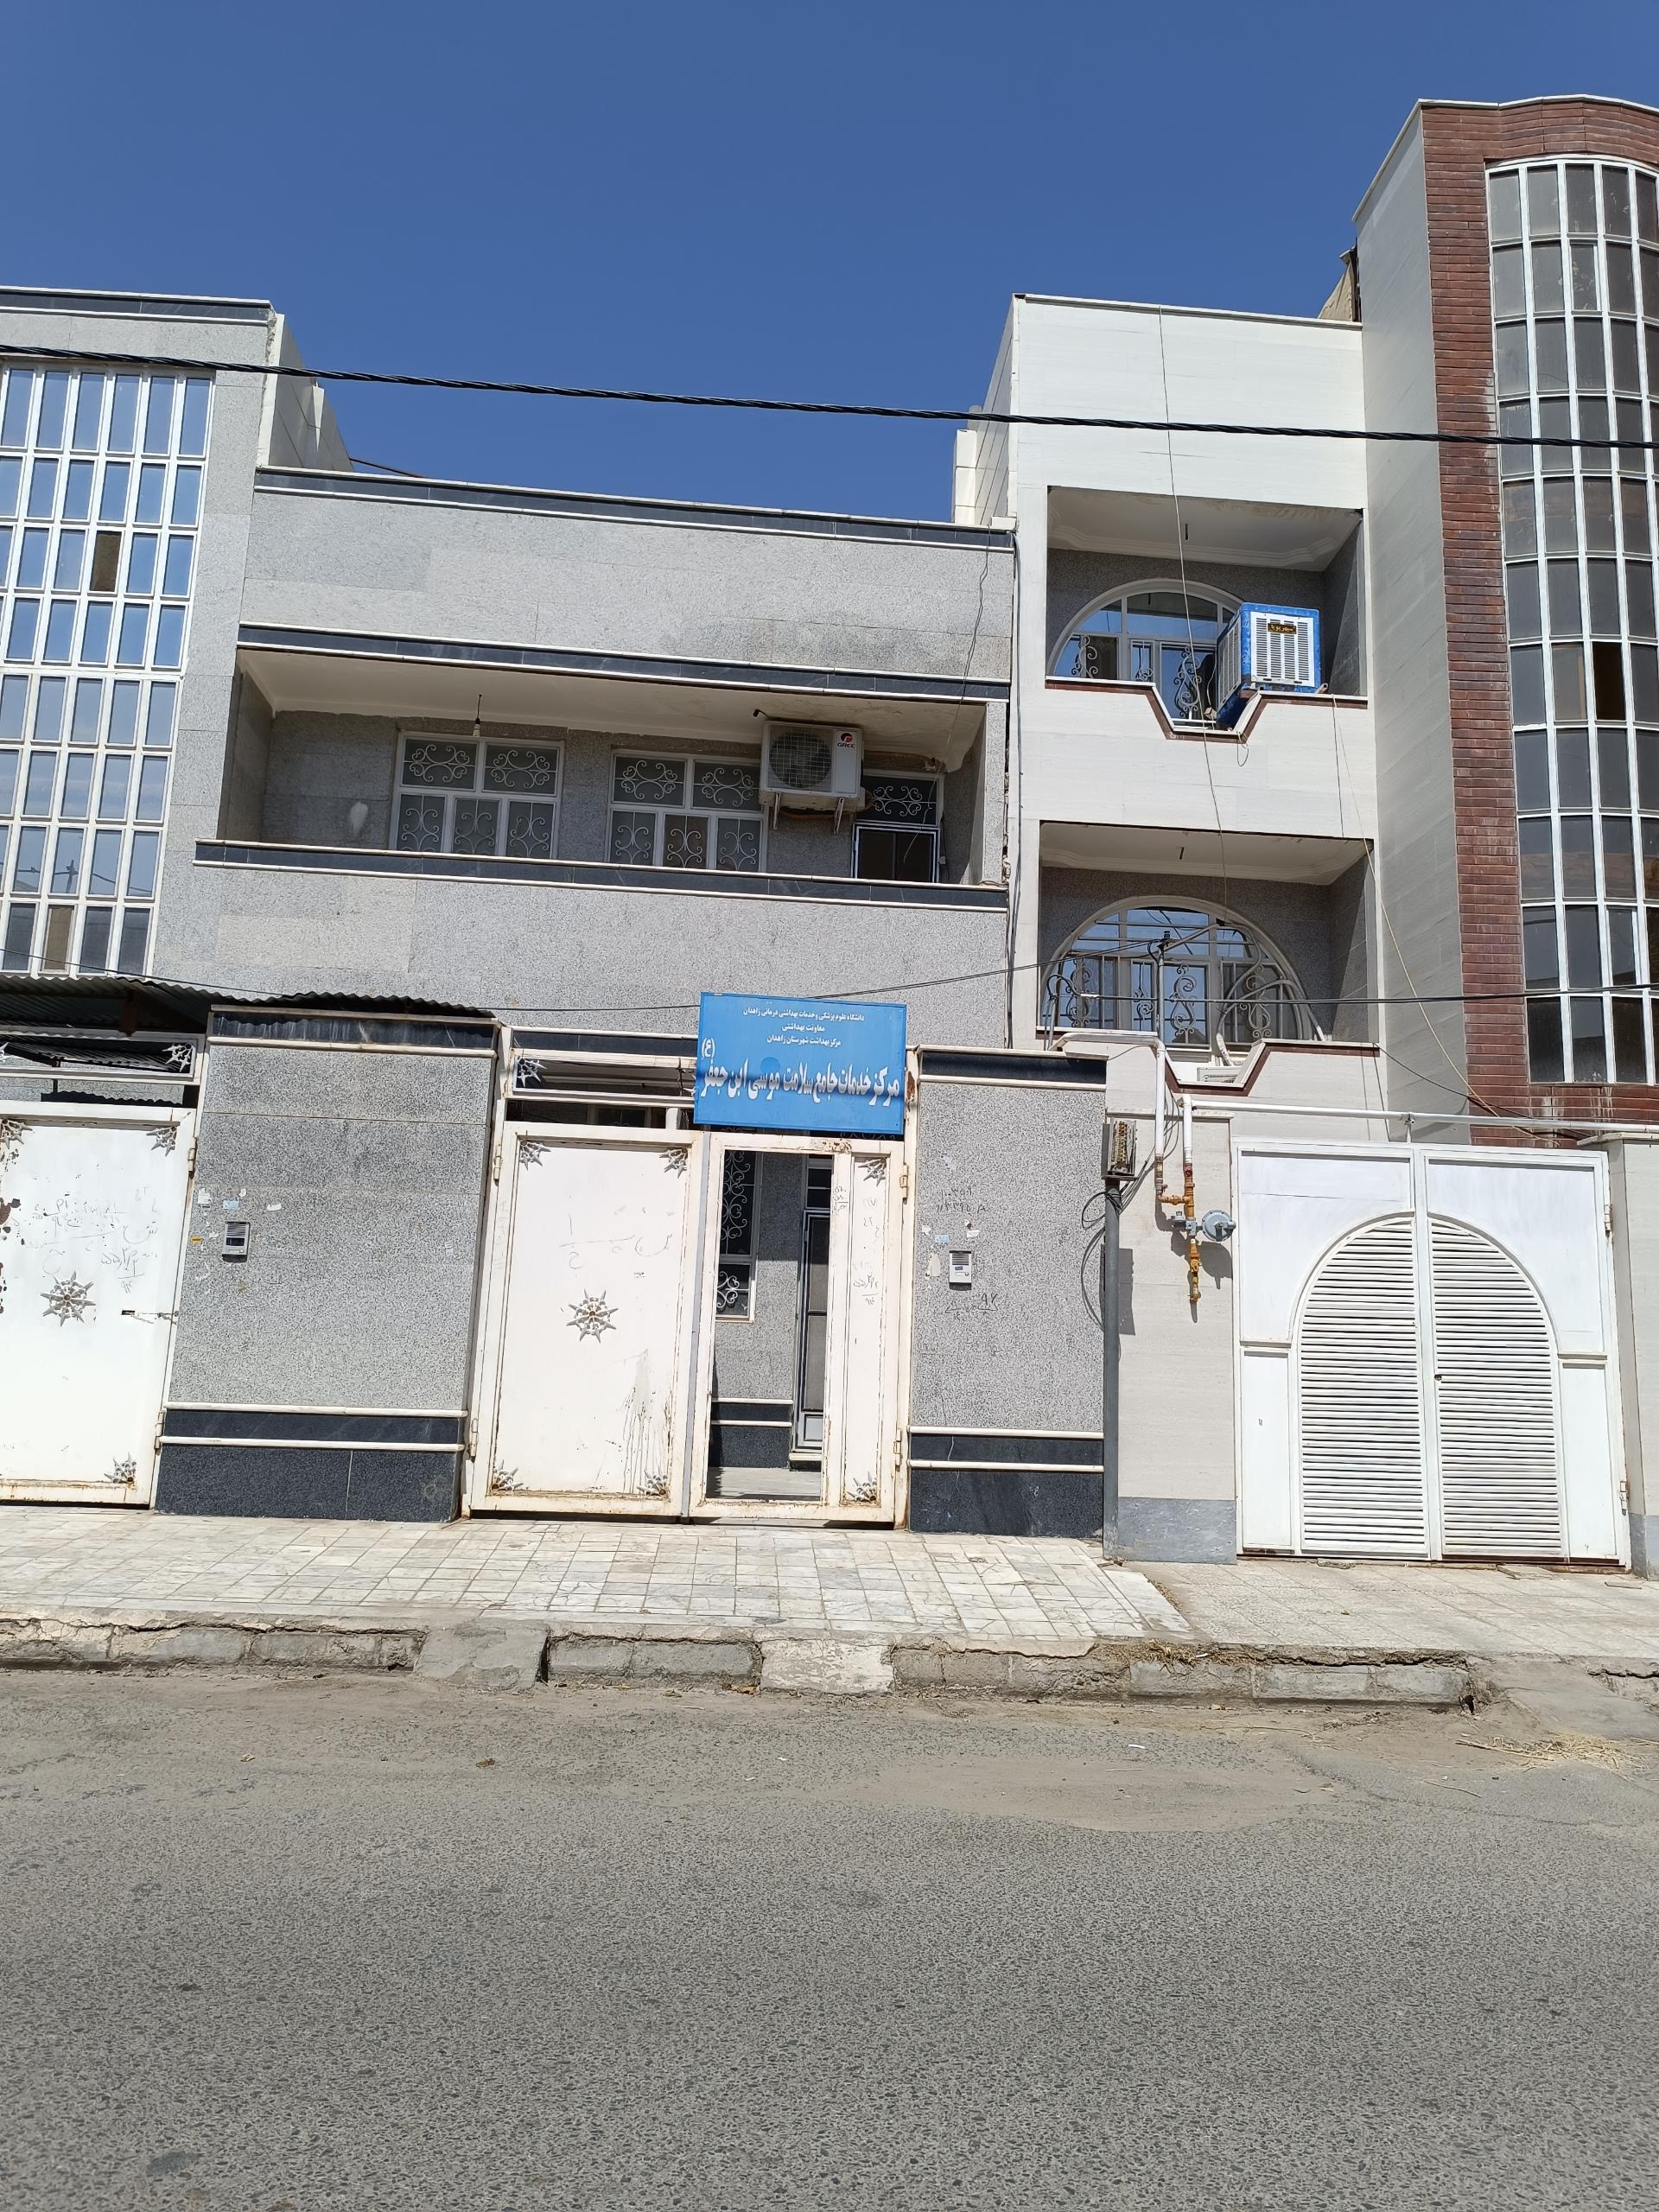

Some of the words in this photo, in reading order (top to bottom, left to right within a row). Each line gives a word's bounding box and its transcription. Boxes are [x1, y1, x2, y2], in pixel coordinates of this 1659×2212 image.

[742, 1006, 761, 1017] زاهدان
[760, 1007, 779, 1018] درمانی
[778, 1008, 798, 1019] بهداشتی
[818, 1012, 836, 1022] پزشکی
[846, 1013, 865, 1021] دانشگاه
[835, 1013, 847, 1022] علوم
[781, 1022, 805, 1033] بهداشتی
[805, 1024, 826, 1033] معاونت
[766, 1033, 786, 1045] زاهدان
[785, 1034, 810, 1046] شهرستان
[809, 1036, 830, 1047] بهداشت
[829, 1038, 842, 1048] مرکز
[701, 1037, 716, 1058] (ع)
[700, 1058, 728, 1098] جعفر
[728, 1057, 749, 1099] ابن
[783, 1061, 814, 1096] سلامت
[812, 1062, 838, 1103] جامع
[837, 1063, 872, 1096] خدمات
[747, 1071, 780, 1101] موسی
[868, 1066, 900, 1107] مرکز
